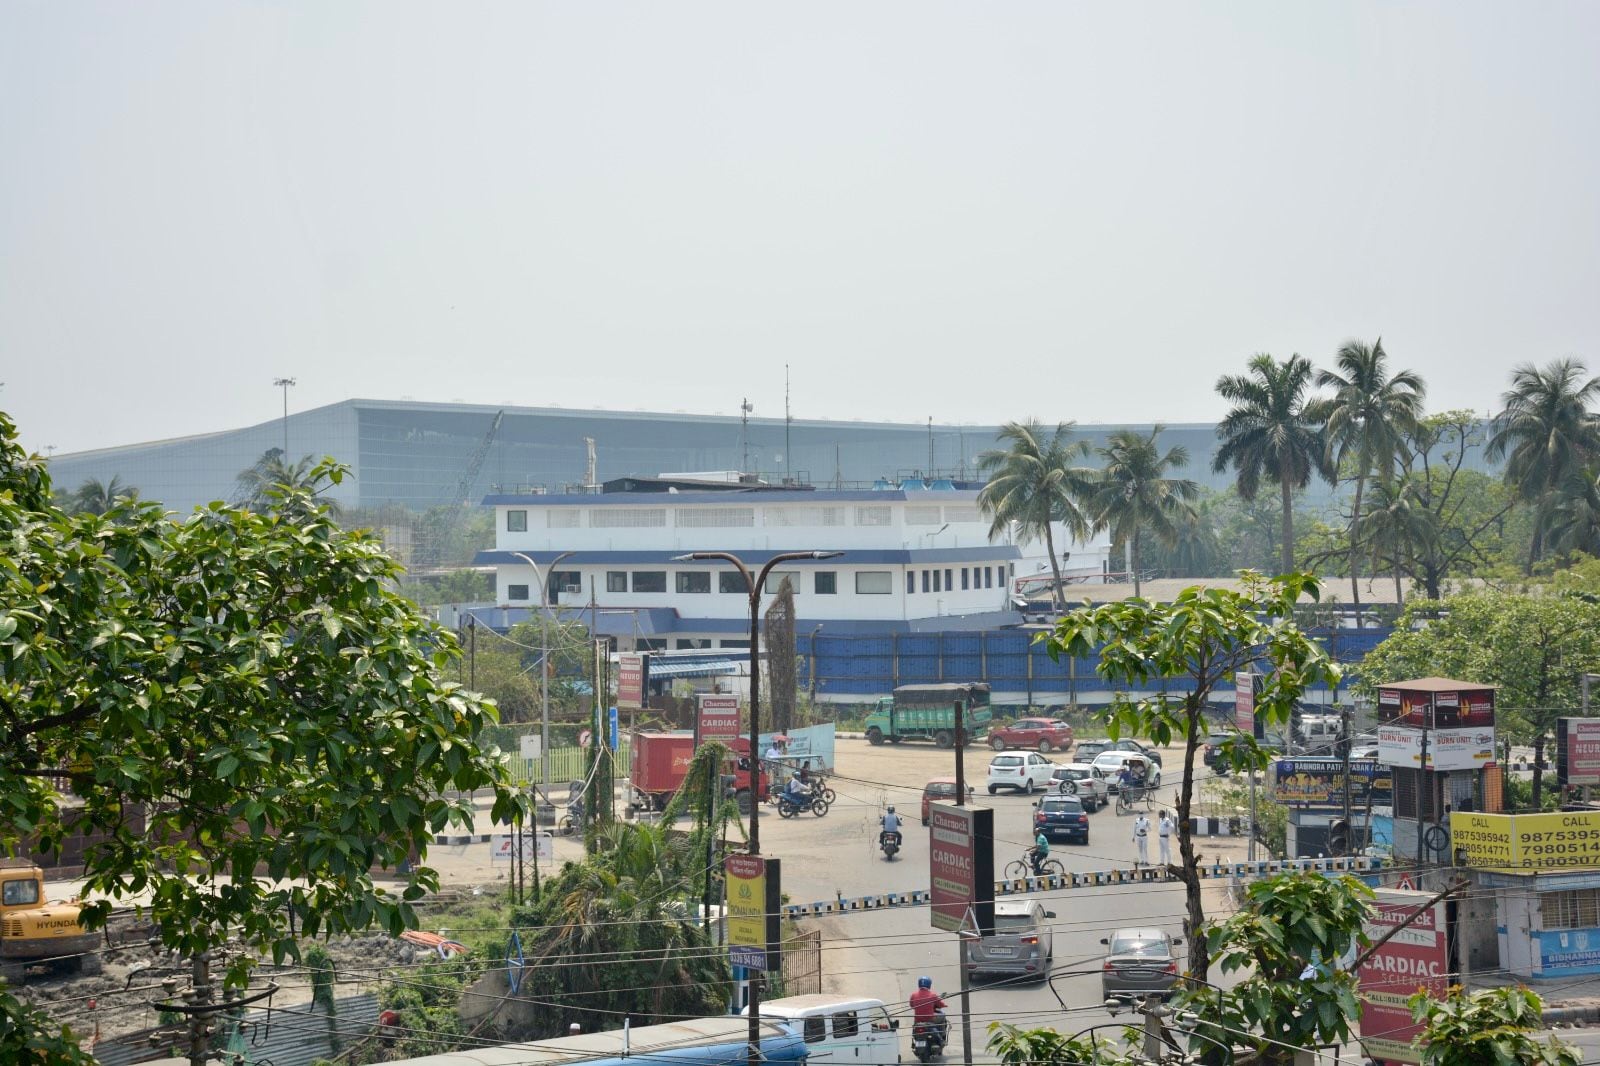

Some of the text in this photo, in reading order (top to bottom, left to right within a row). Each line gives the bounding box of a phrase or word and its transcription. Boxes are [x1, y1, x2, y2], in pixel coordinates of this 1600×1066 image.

[702, 719, 737, 727] CARDIAC
[934, 814, 968, 832] Charnock
[1471, 817, 1489, 829] CALL
[1562, 816, 1592, 827] CALL
[1453, 829, 1510, 844] 9875395942
[932, 848, 971, 870] CARDIAC
[37, 920, 76, 929] HYUNDA
[1382, 973, 1441, 990] SCIENCES
